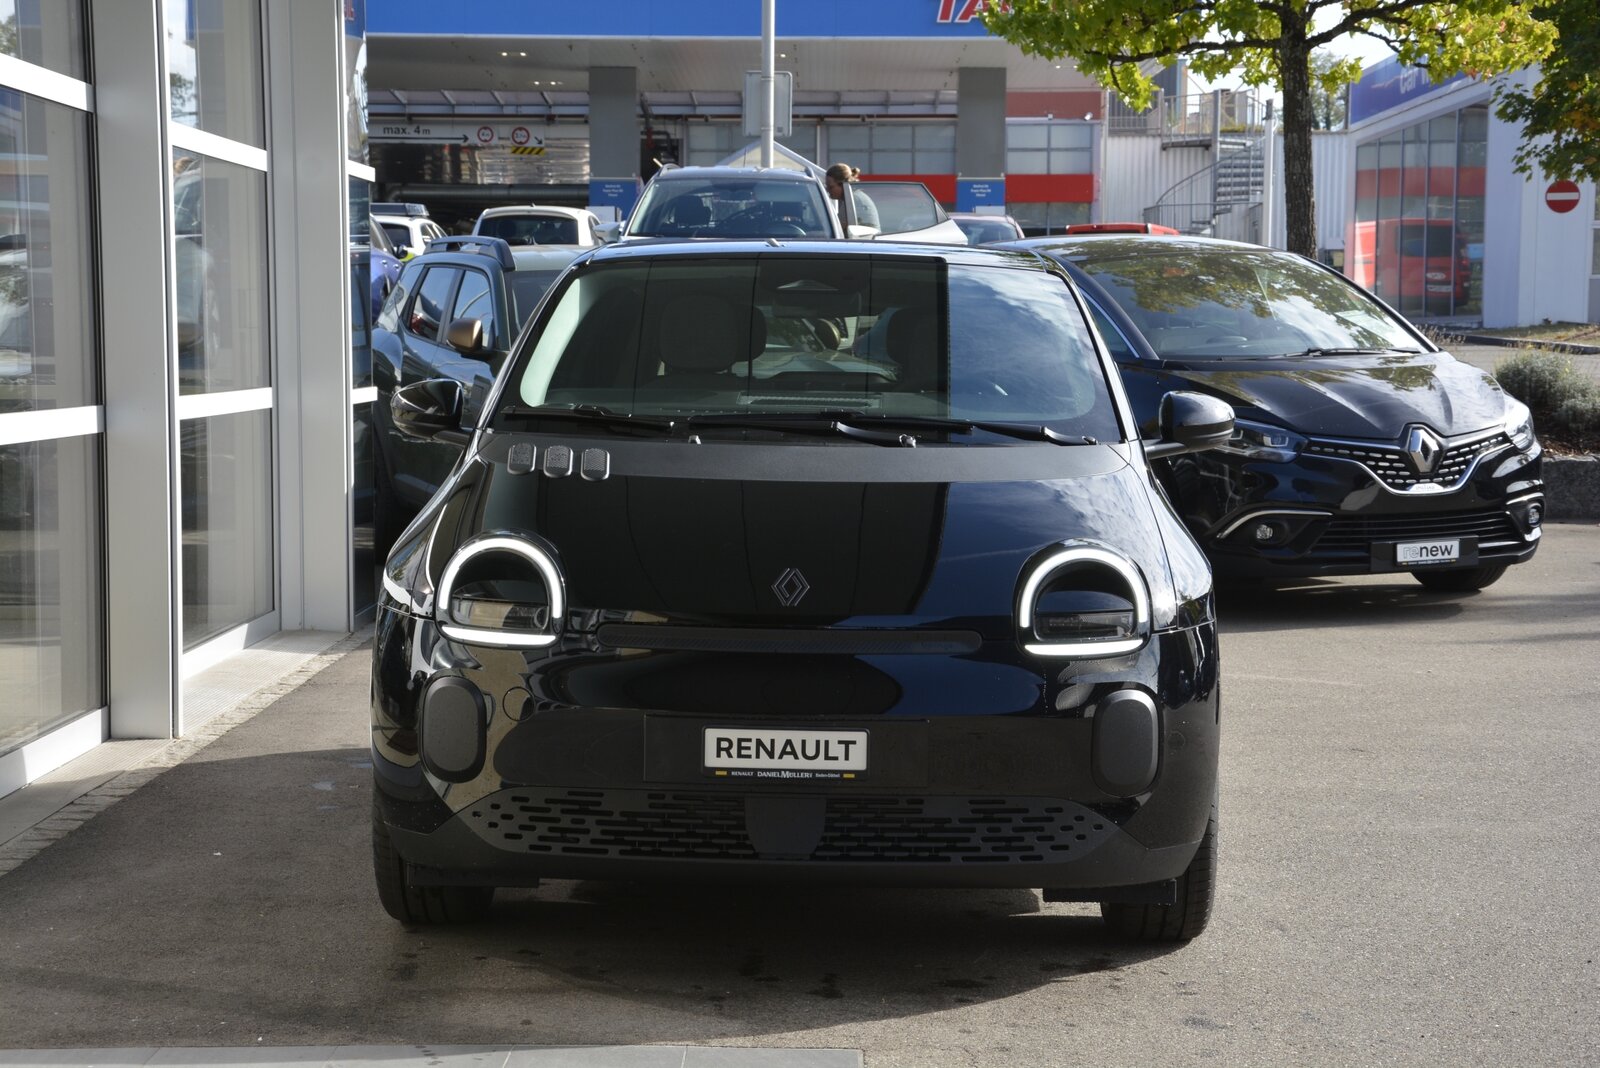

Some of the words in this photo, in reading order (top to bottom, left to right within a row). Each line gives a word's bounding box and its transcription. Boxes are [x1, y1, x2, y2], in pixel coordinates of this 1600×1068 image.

[383, 126, 411, 135] max.
[1403, 544, 1453, 559] renew
[715, 737, 857, 761] RENAULT
